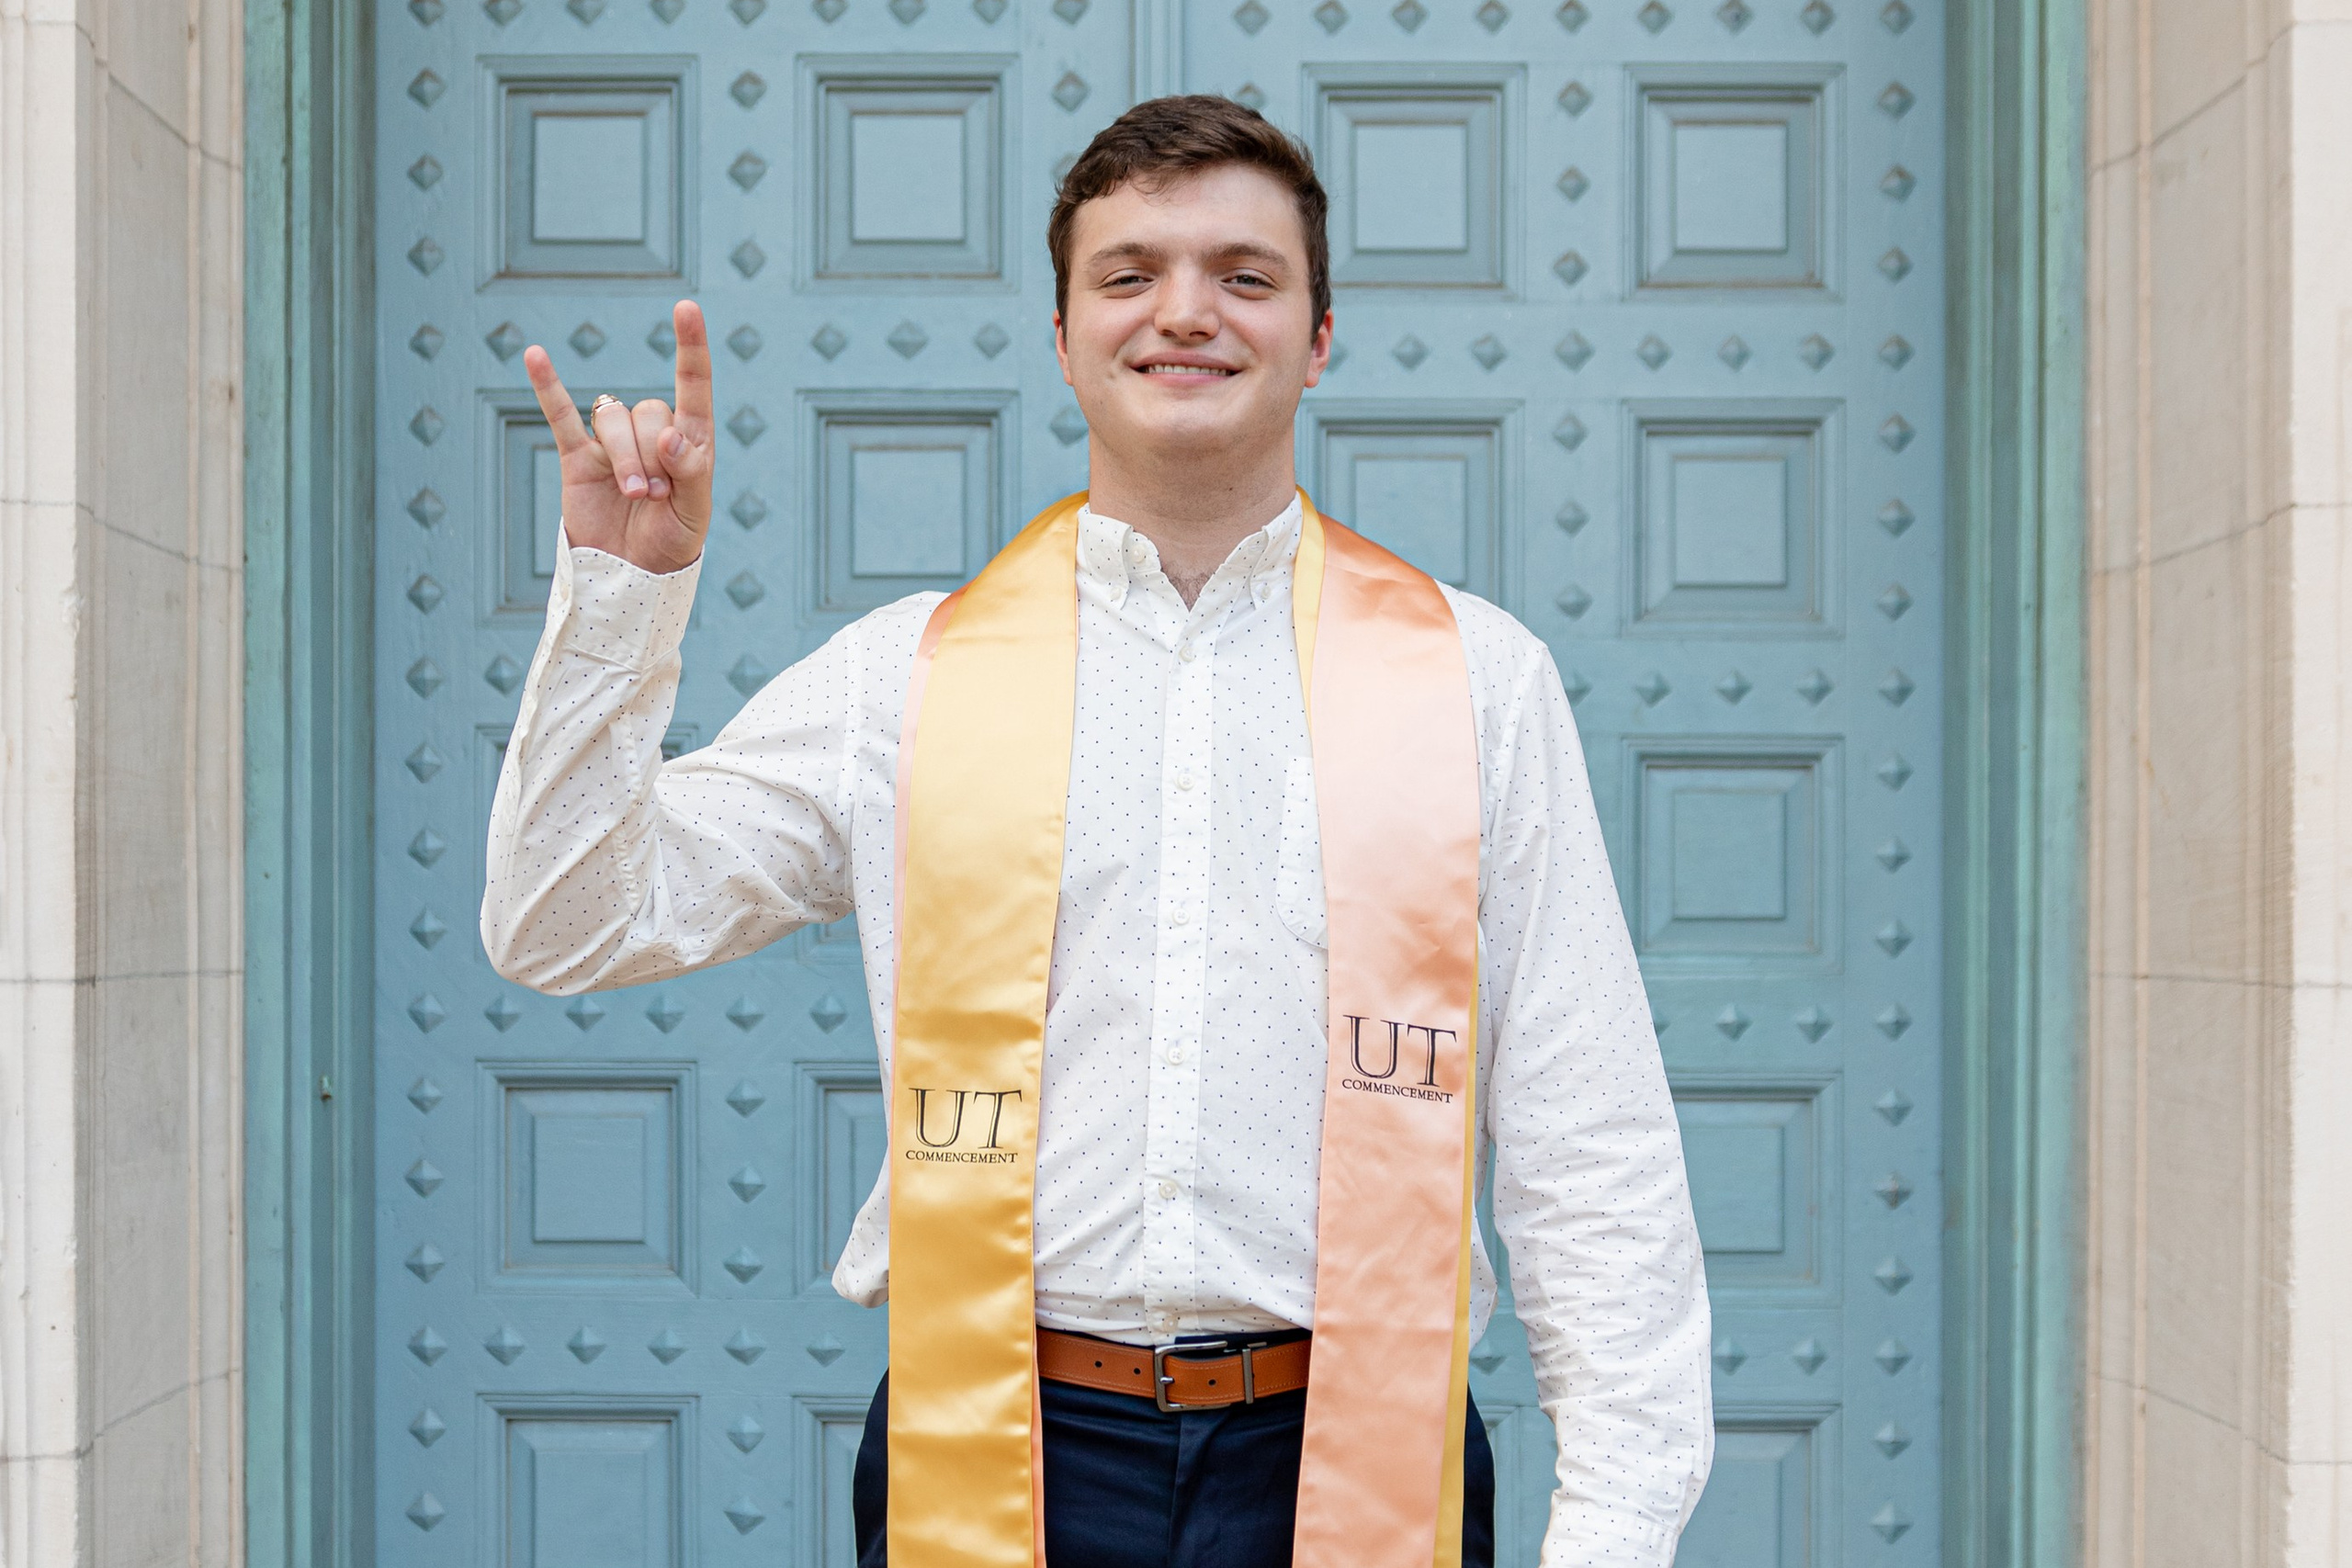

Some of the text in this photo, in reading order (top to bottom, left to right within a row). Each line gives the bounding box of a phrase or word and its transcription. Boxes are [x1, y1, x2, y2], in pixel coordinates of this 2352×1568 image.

[1342, 1014, 1457, 1088] UT
[1341, 1078, 1453, 1103] COMMENCEMENT
[908, 1088, 1023, 1149] UT
[905, 1149, 1018, 1164] COMMENCEMENT
